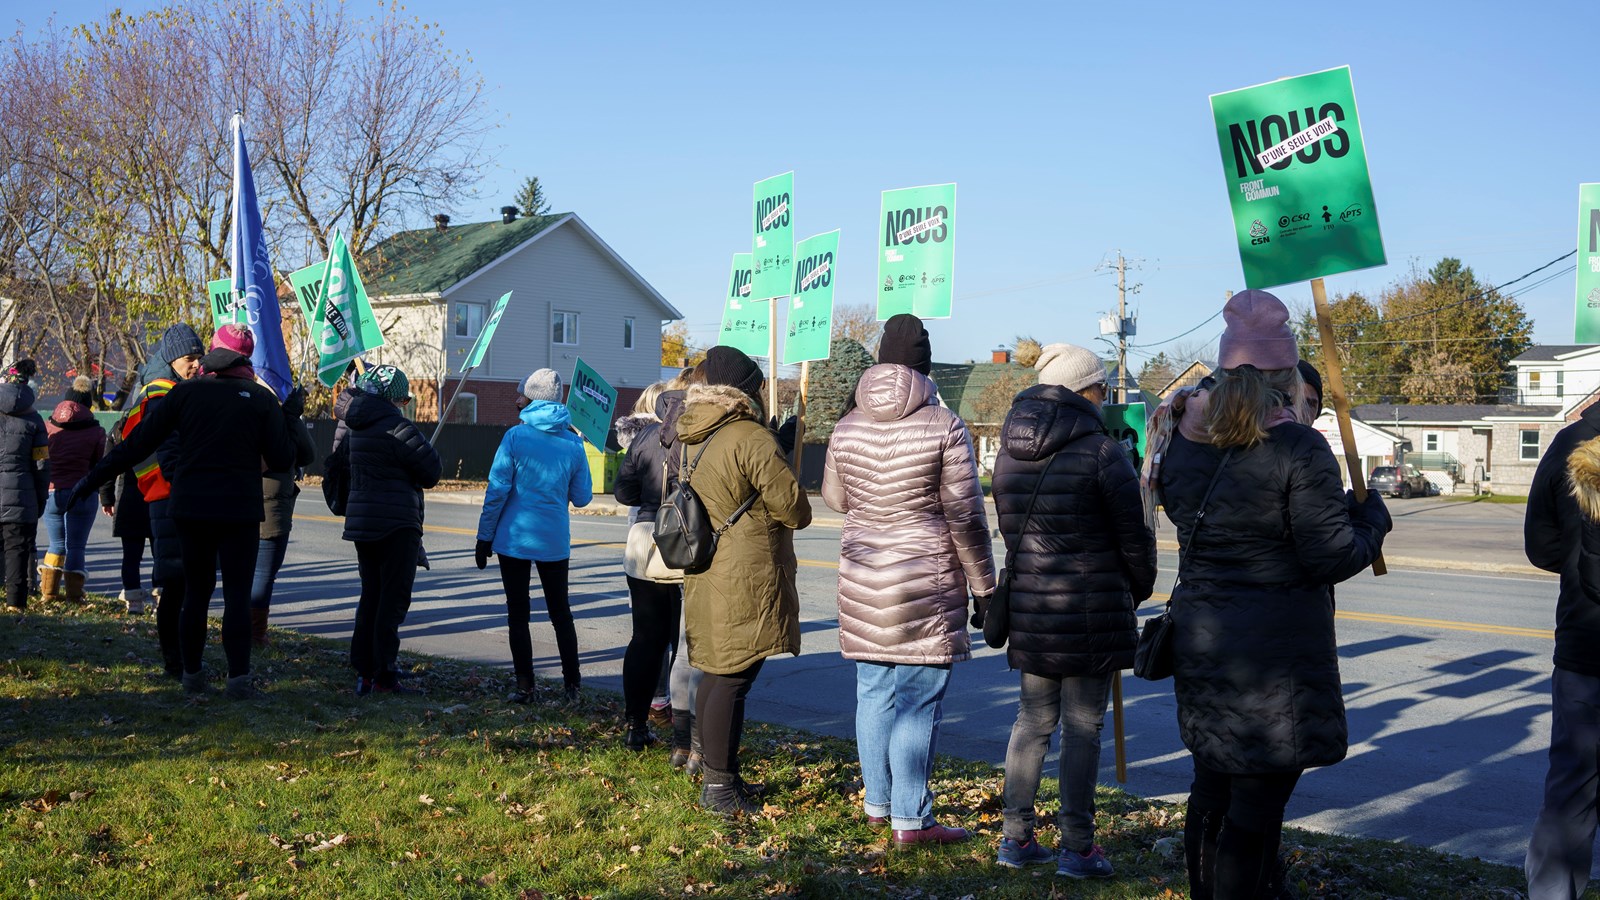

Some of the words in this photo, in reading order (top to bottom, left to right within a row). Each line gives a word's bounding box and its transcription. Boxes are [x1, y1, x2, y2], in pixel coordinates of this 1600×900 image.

[1229, 102, 1350, 178] NOUS
[1262, 144, 1288, 165] D'UNE
[1288, 132, 1314, 151] SEULE
[1312, 120, 1334, 138] VOIX
[1240, 179, 1264, 194] FRONT
[1245, 186, 1280, 202] COMMUN
[756, 192, 790, 234] NOUS
[886, 206, 948, 246] NOUS
[912, 222, 927, 234] SEULE
[927, 216, 941, 228] VOIX
[1291, 213, 1310, 222] CSQ
[1339, 208, 1362, 222] APTS
[1251, 236, 1270, 246] CSN
[794, 252, 833, 294] NOUS
[576, 370, 612, 414] NOUS
